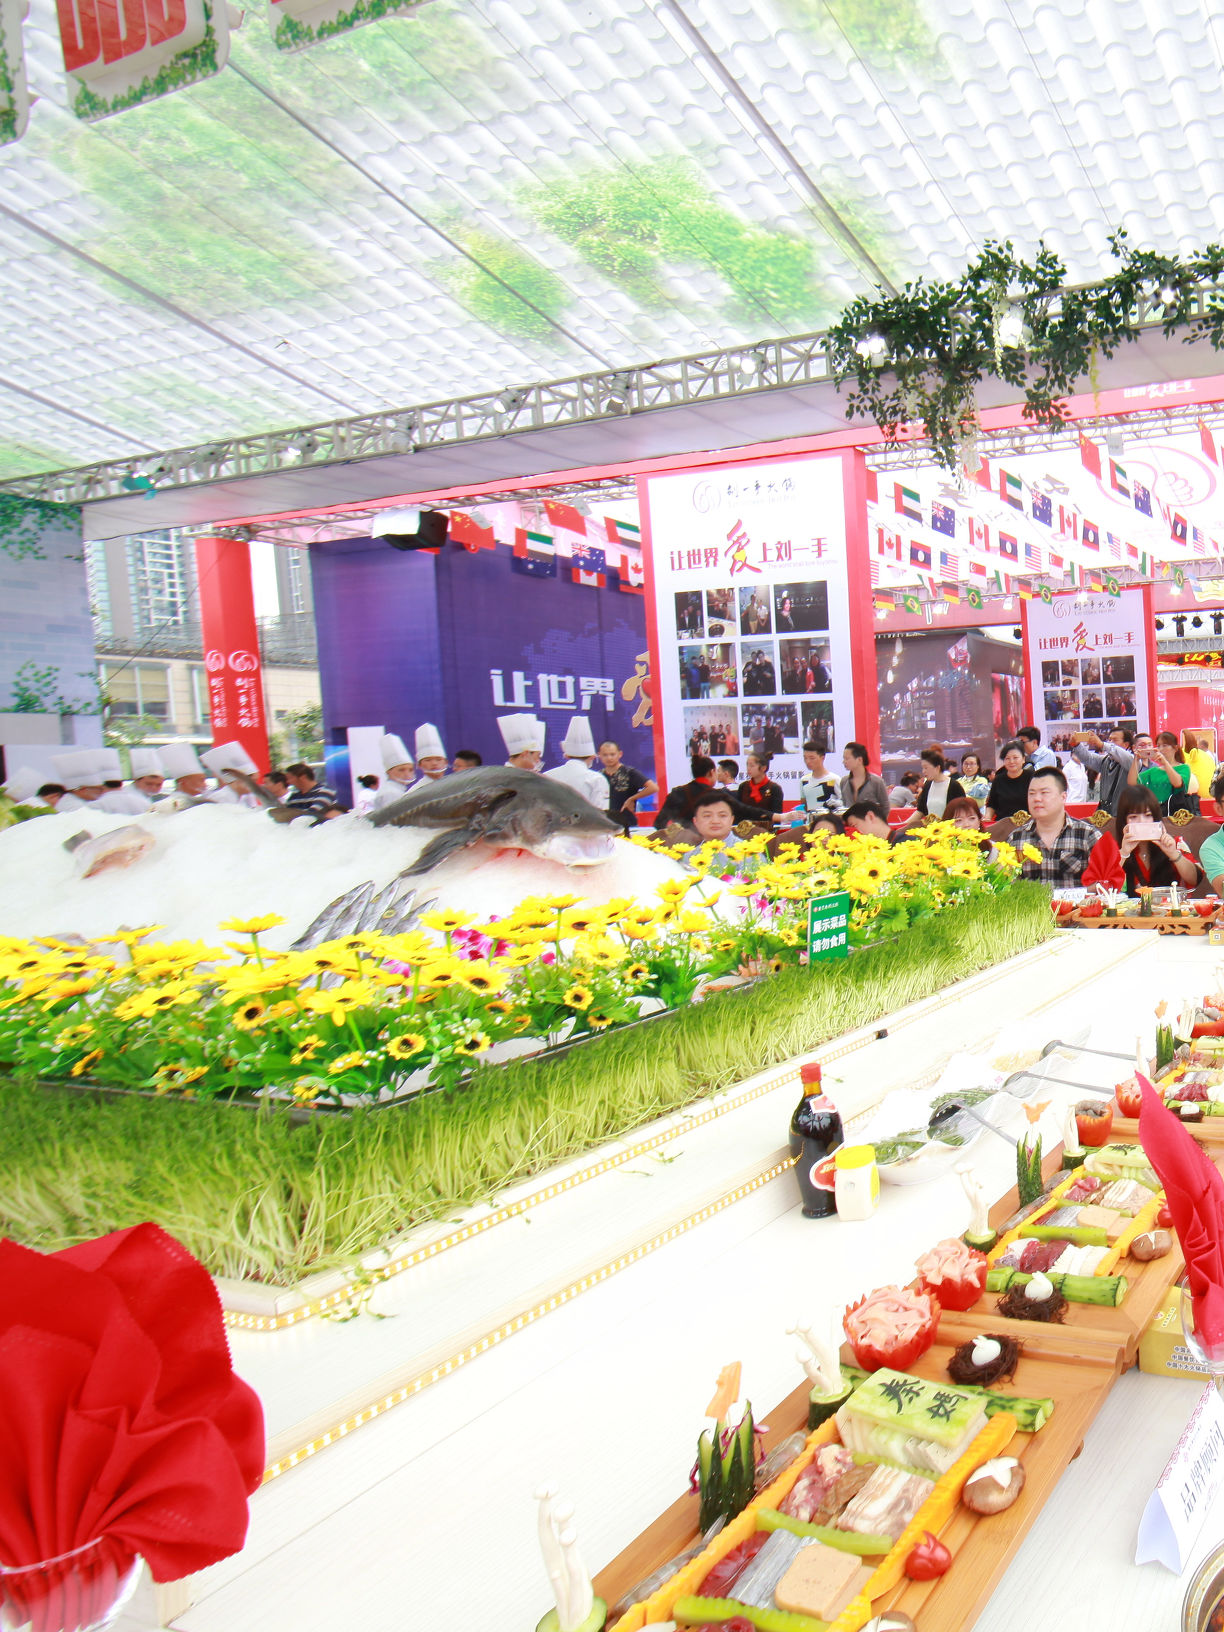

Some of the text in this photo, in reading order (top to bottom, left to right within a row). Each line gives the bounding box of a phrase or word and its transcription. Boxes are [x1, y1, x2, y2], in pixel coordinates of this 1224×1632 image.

[813, 914, 847, 935] 展示菜品
[812, 932, 847, 953] 请勿食用
